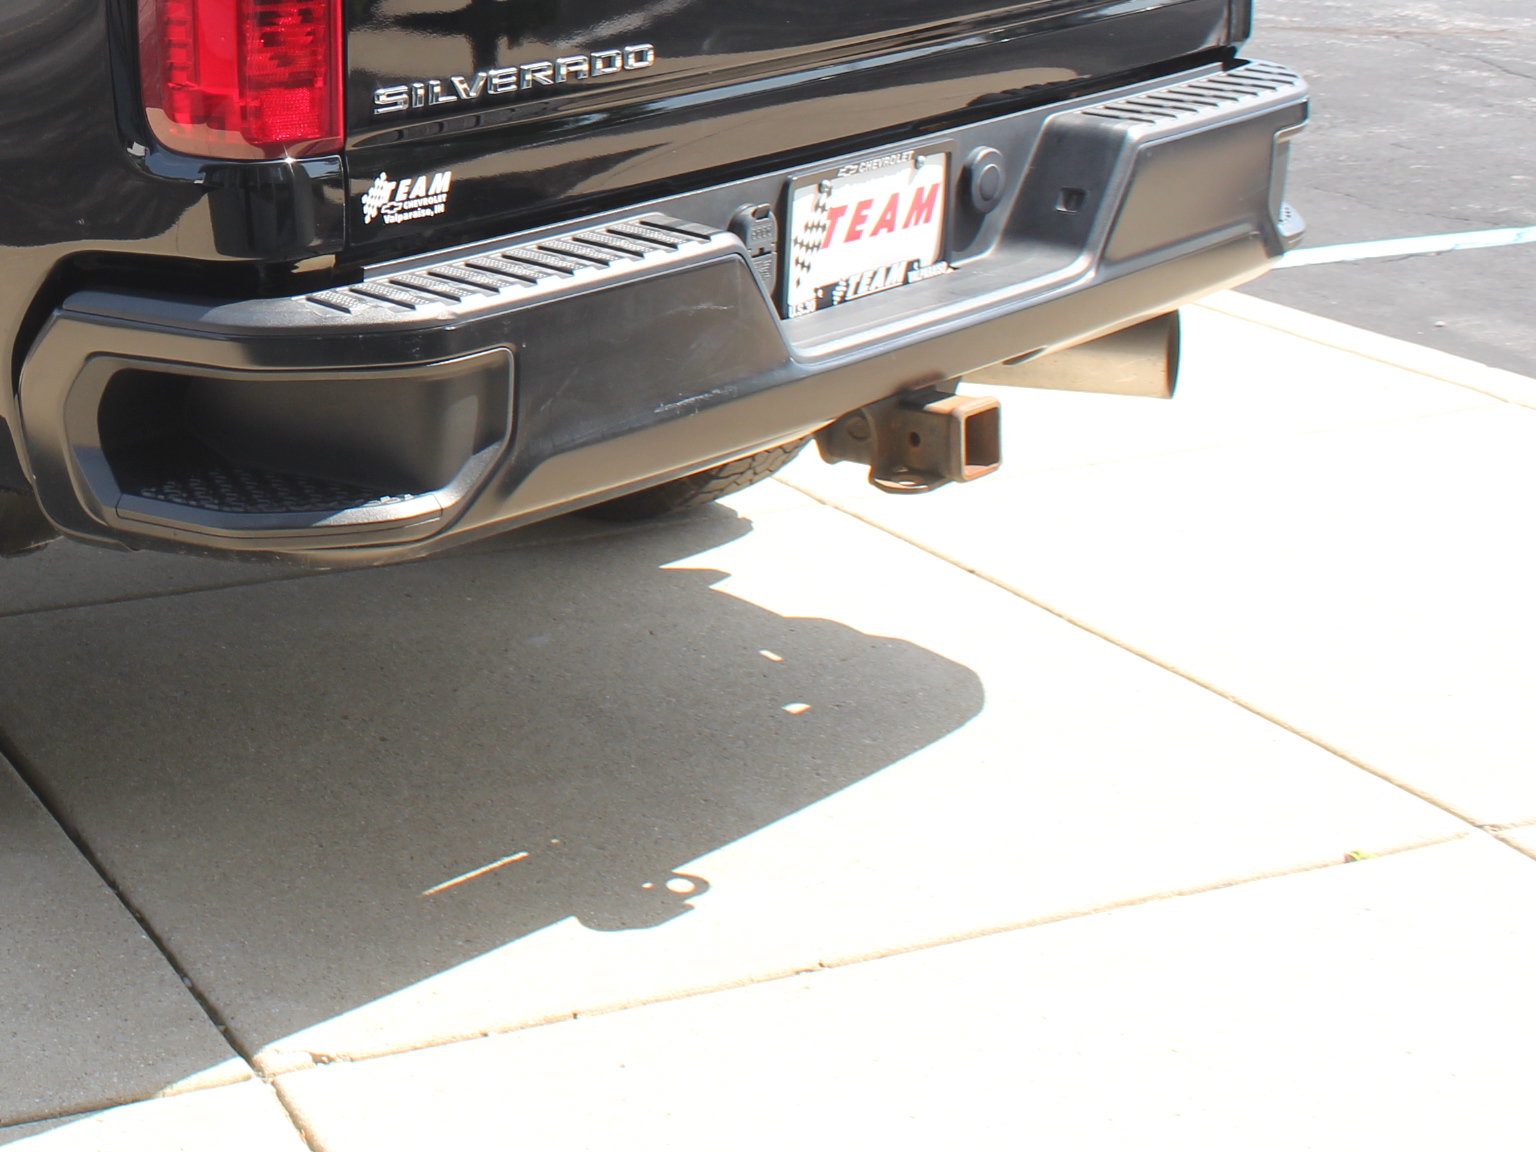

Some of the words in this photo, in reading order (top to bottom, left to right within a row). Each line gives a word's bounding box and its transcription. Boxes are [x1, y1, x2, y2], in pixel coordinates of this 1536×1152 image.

[373, 43, 655, 115] SILVERADO
[858, 150, 915, 173] CHEVROLET
[381, 171, 452, 205] TEAM
[403, 194, 447, 210] CHEVROLET
[433, 203, 445, 214] IN
[821, 182, 941, 249] TEAM
[846, 260, 909, 297] TEAM
